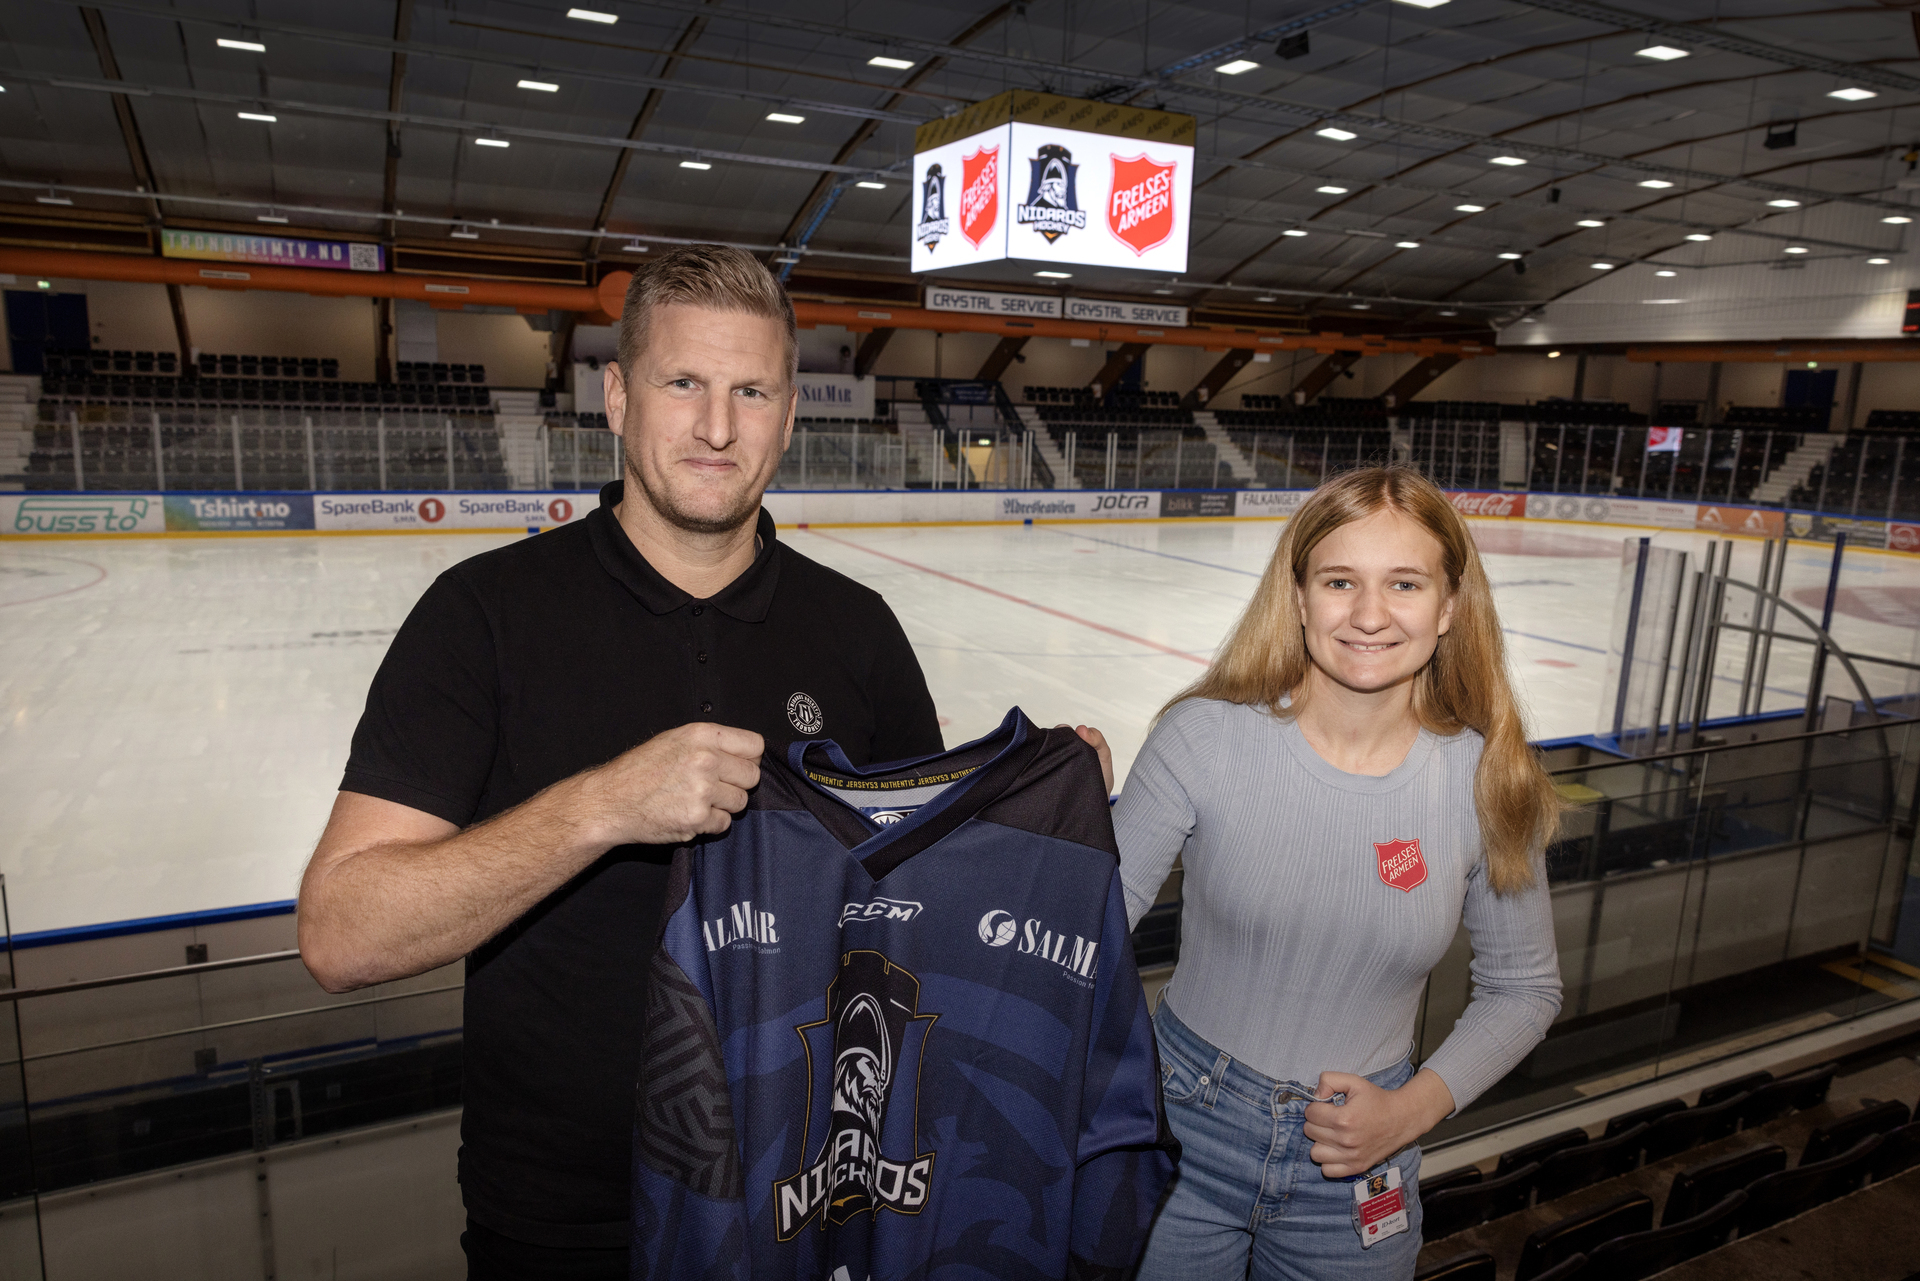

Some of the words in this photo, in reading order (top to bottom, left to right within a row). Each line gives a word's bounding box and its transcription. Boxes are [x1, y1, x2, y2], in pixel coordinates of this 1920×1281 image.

[1018, 205, 1086, 228] NIDAROS
[1117, 191, 1170, 234] ARMEEN
[933, 293, 995, 310] CRYSTAL
[1001, 298, 1055, 314] SERVICE
[1071, 303, 1126, 319] CRYSTAL
[1132, 308, 1180, 323] SERVICE
[190, 497, 291, 518] Tshirt.no
[321, 499, 415, 516] SpareBank
[459, 499, 545, 515] SpareBank
[809, 771, 844, 787] AUTHENTIC
[846, 780, 879, 789] JERSEY53
[880, 778, 915, 789] AUTHENTIC
[917, 774, 950, 785] JERSEY53
[1389, 855, 1419, 882] ARMEEN
[843, 902, 914, 922] CCM
